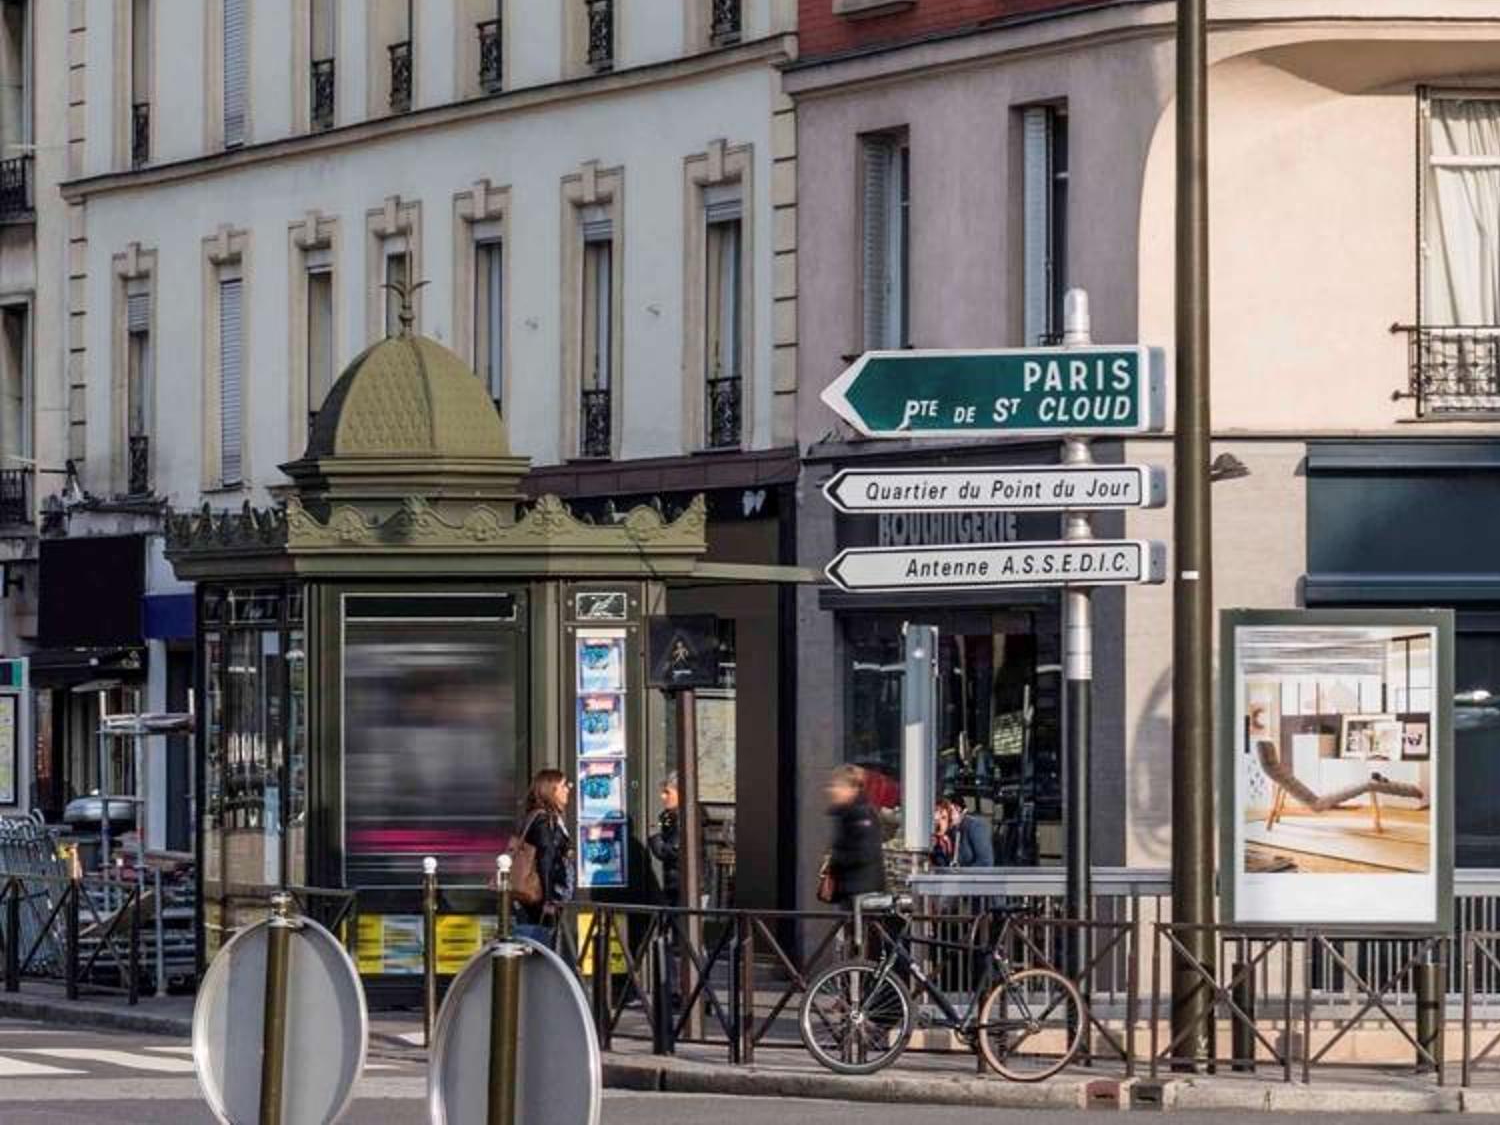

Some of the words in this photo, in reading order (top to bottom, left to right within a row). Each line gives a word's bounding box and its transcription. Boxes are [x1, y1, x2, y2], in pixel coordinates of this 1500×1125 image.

[1023, 360, 1131, 392] PARIS
[953, 406, 976, 424] DE
[1038, 395, 1131, 422] CLOUD
[866, 481, 947, 501] Quartier
[958, 479, 981, 500] du
[991, 479, 1042, 500] Point
[1053, 478, 1076, 499] du
[1086, 477, 1132, 498] Jour
[906, 557, 989, 578] Antenne
[1001, 552, 1131, 575] A.S.S.E.D.I.C.
